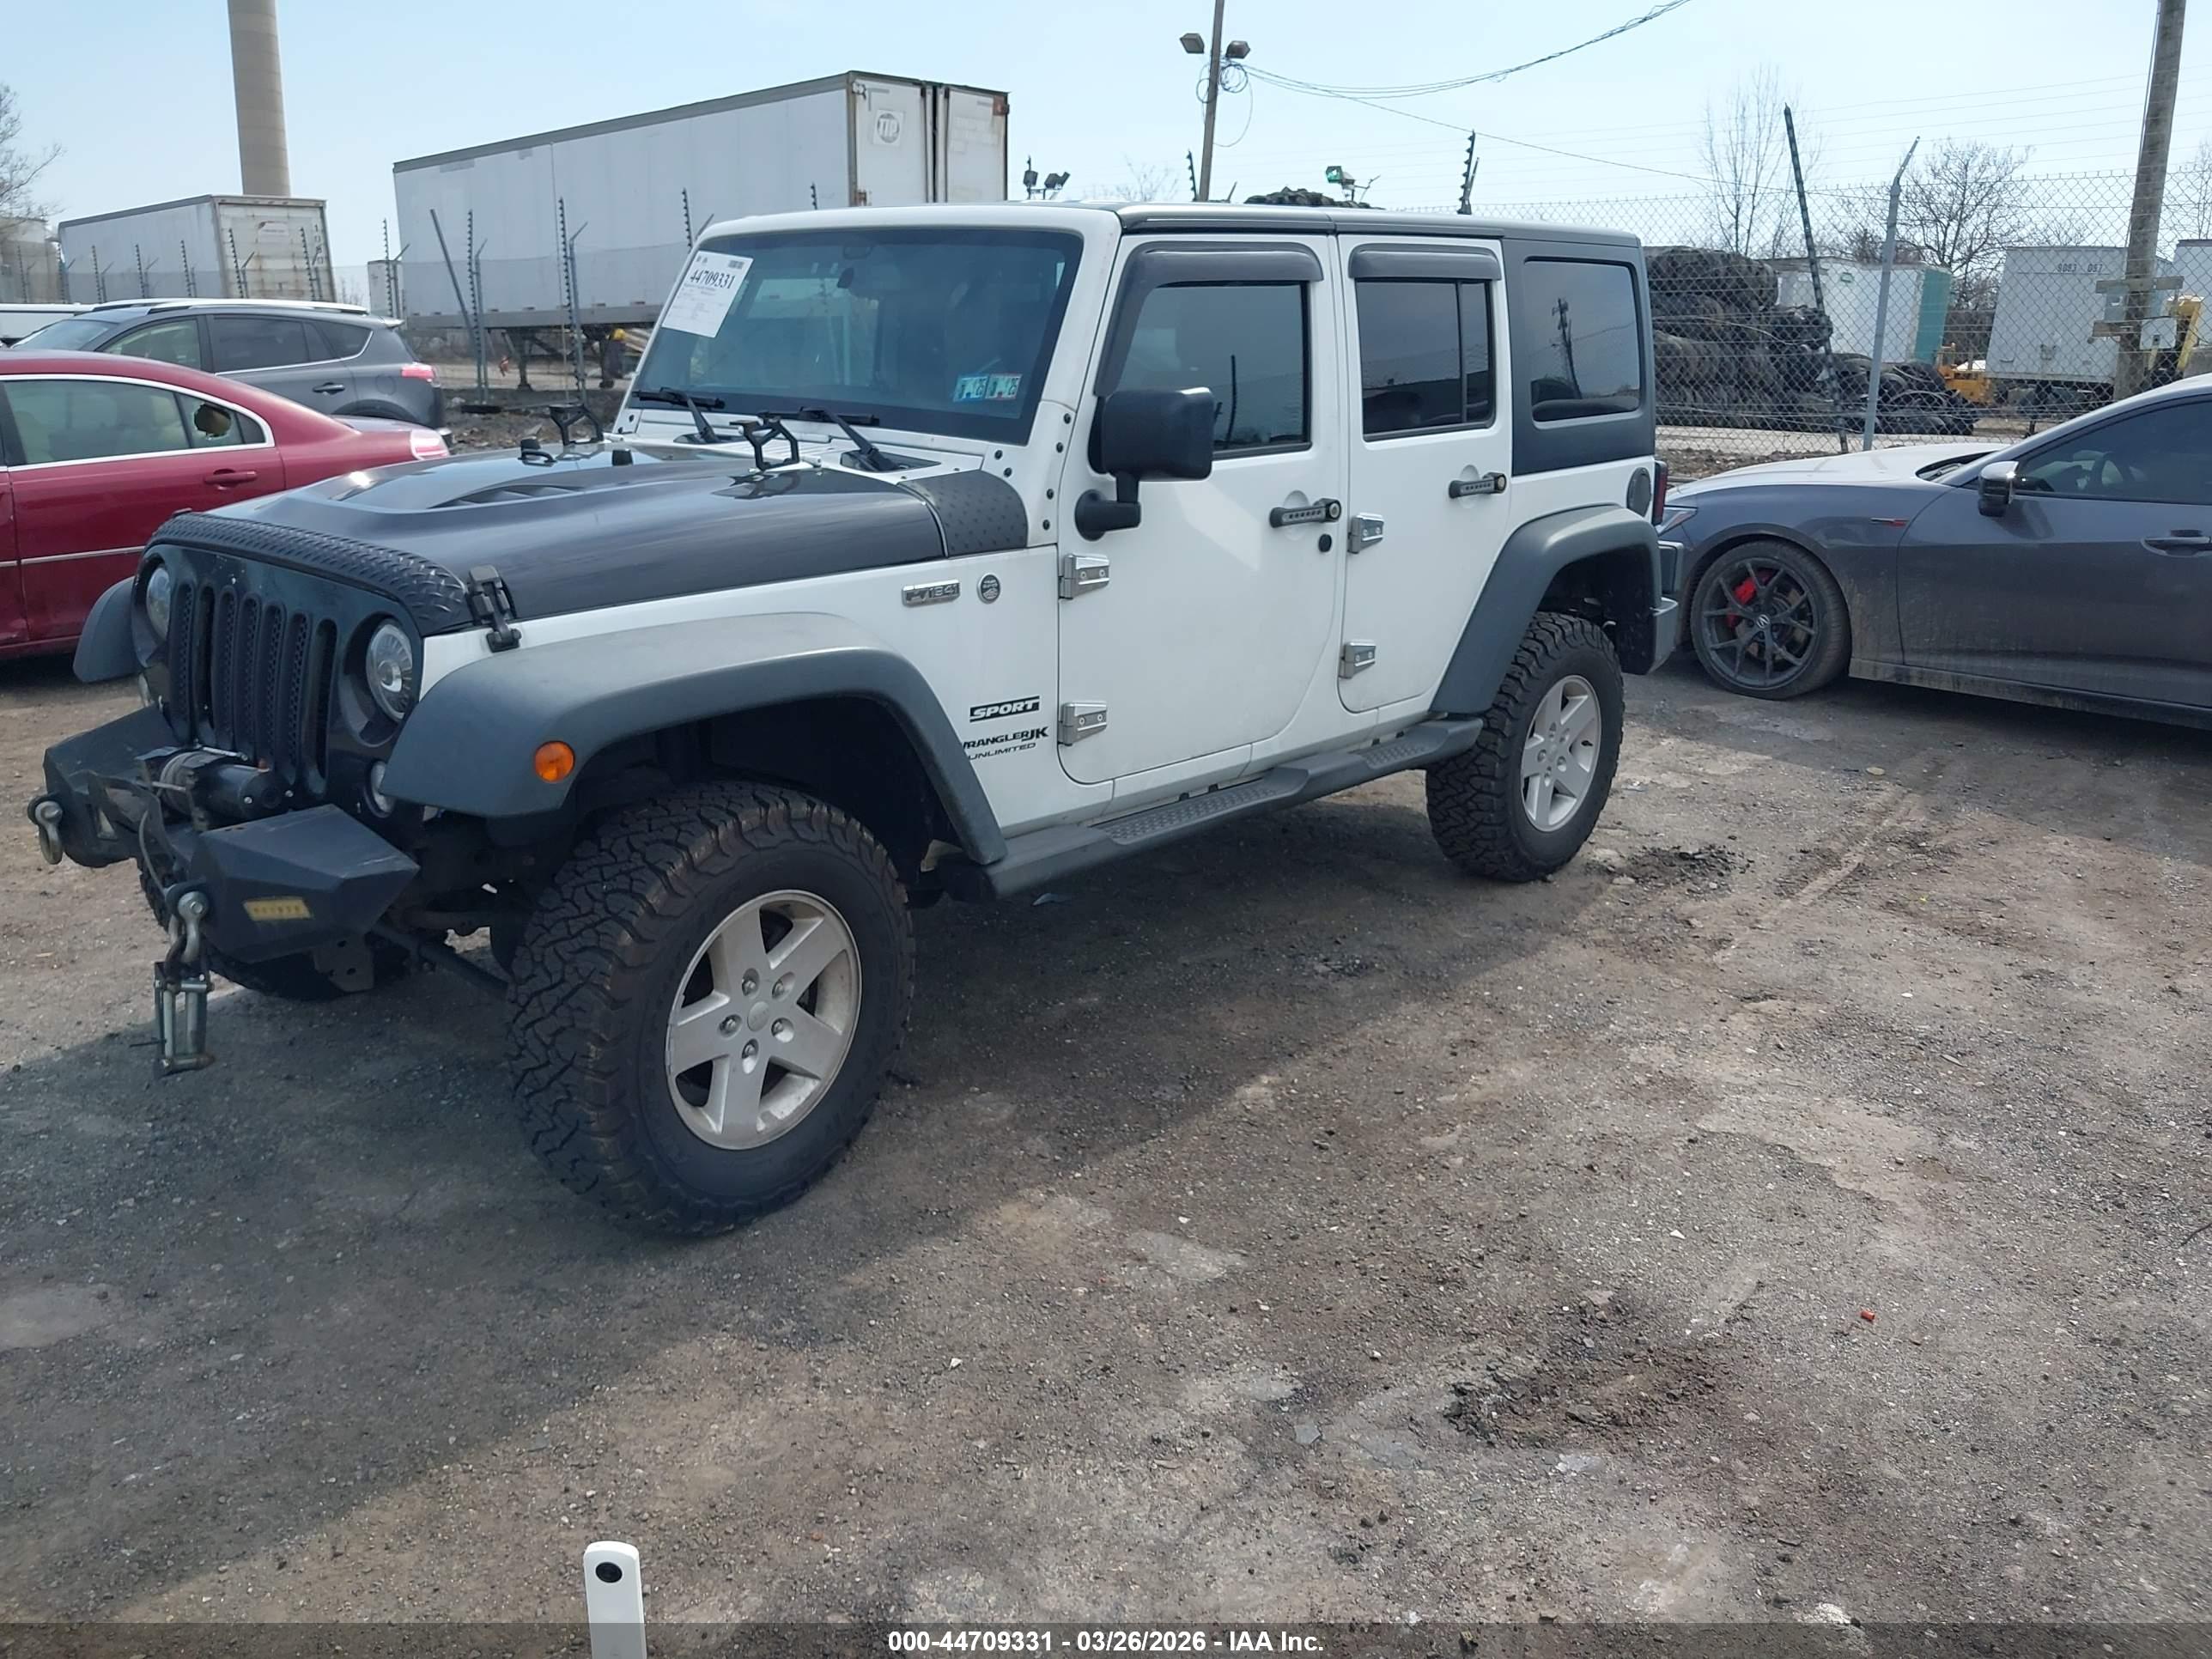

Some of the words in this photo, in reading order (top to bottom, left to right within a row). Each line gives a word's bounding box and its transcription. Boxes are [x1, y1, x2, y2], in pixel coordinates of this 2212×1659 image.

[690, 270, 735, 289] 44709331
[969, 698, 1040, 720] SPORT
[968, 742, 1036, 761] UNLIMITED
